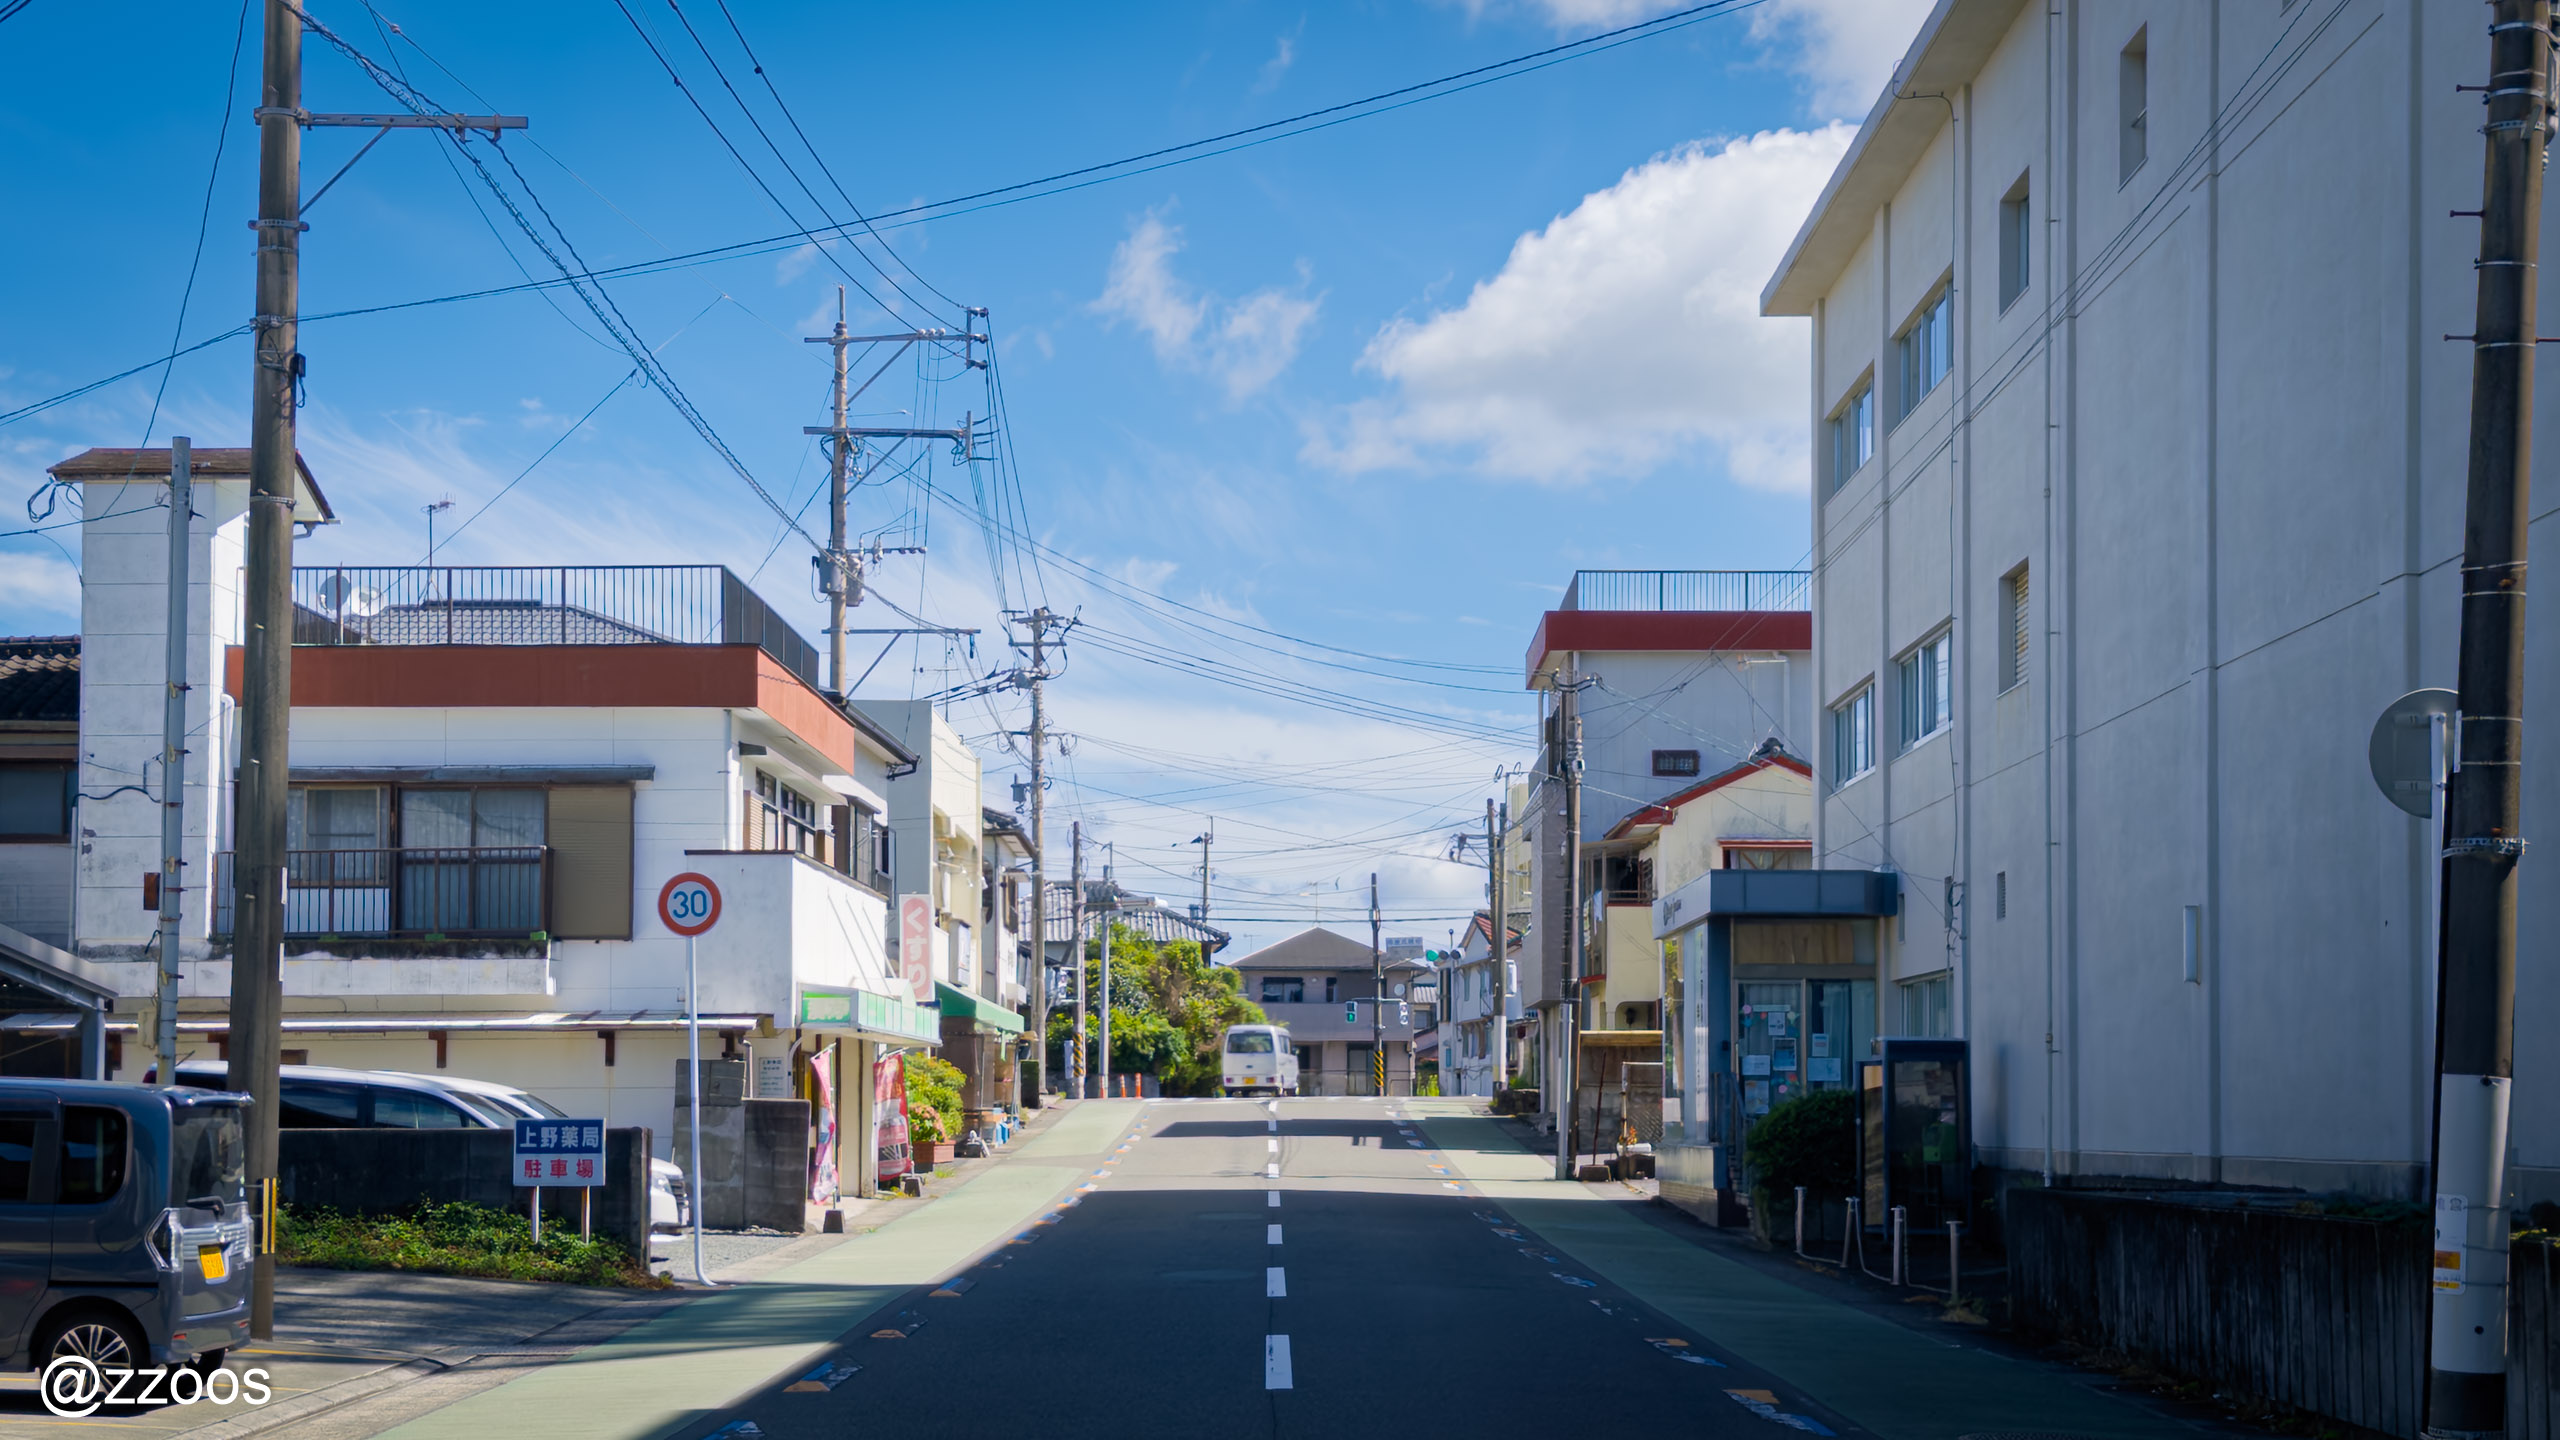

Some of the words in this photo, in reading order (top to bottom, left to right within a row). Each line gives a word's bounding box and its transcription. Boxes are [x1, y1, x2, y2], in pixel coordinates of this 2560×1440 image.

[672, 889, 708, 919] 30
[906, 906, 928, 990] くすり
[519, 1125, 600, 1149] 上野薬局
[524, 1158, 594, 1179] 駐車場
